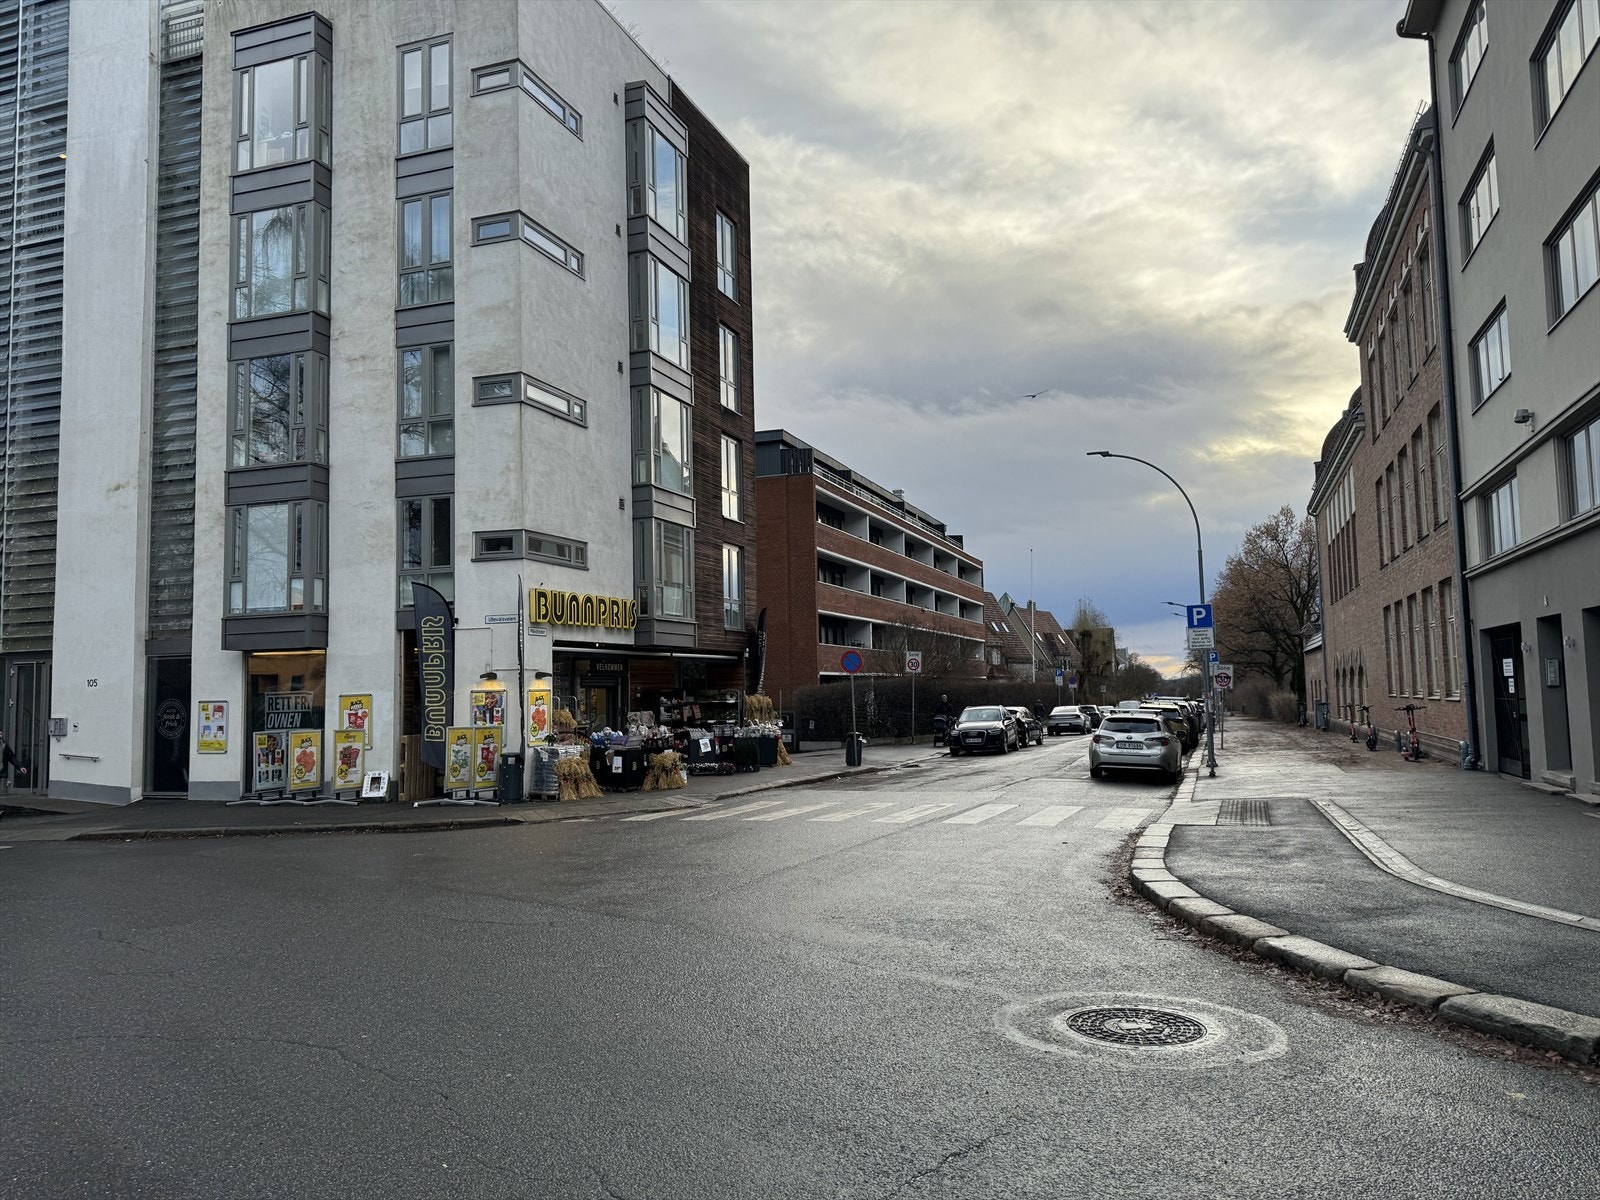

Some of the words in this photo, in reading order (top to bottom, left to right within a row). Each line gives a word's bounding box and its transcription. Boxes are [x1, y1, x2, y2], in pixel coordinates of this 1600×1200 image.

[529, 588, 638, 630] BUNNPRIS
[1193, 608, 1206, 625] P
[1210, 653, 1216, 661] P
[87, 678, 98, 688] 105
[267, 696, 292, 711] RETT
[267, 712, 302, 728] OVNEN
